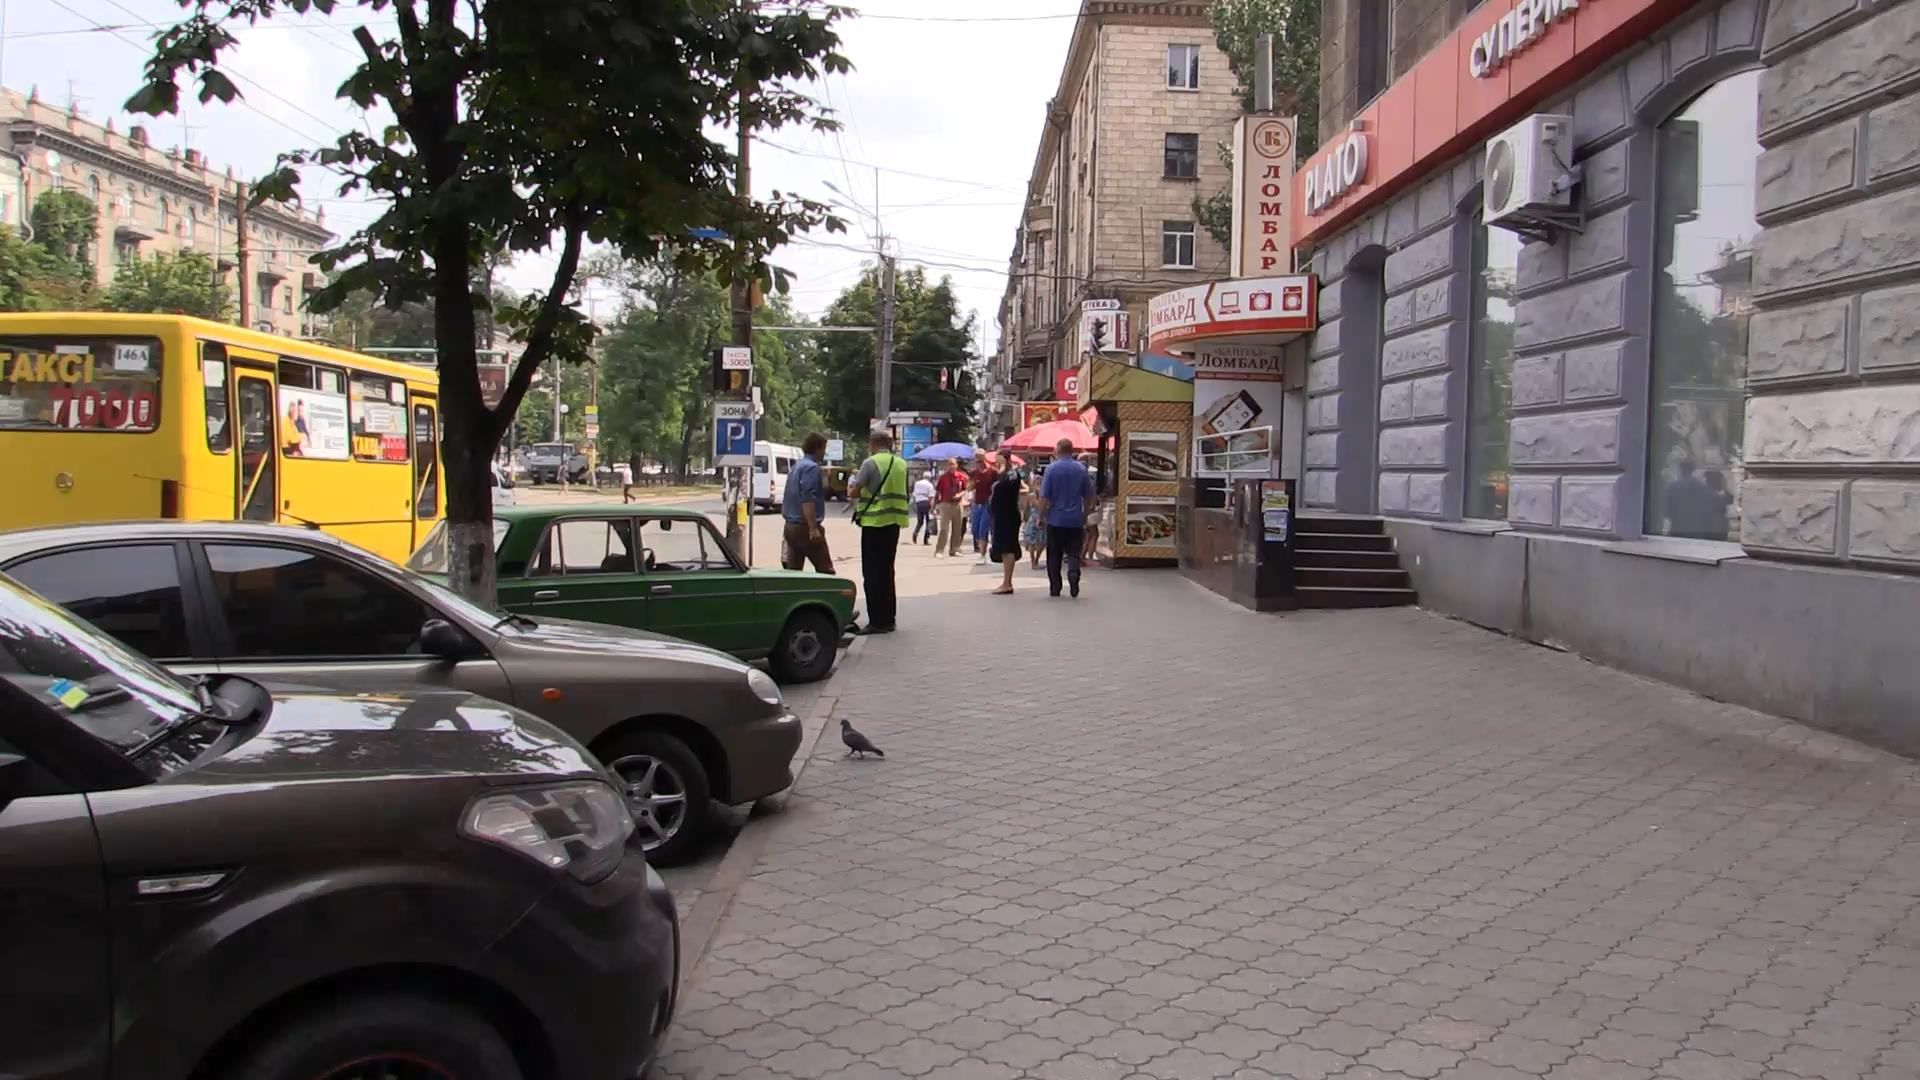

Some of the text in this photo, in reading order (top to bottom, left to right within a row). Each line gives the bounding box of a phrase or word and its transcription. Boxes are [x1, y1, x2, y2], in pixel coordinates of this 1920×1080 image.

[1470, 0, 1580, 78] СУПЕРМ
[1258, 164, 1282, 270] ЛОМБАР
[727, 422, 745, 451] P
